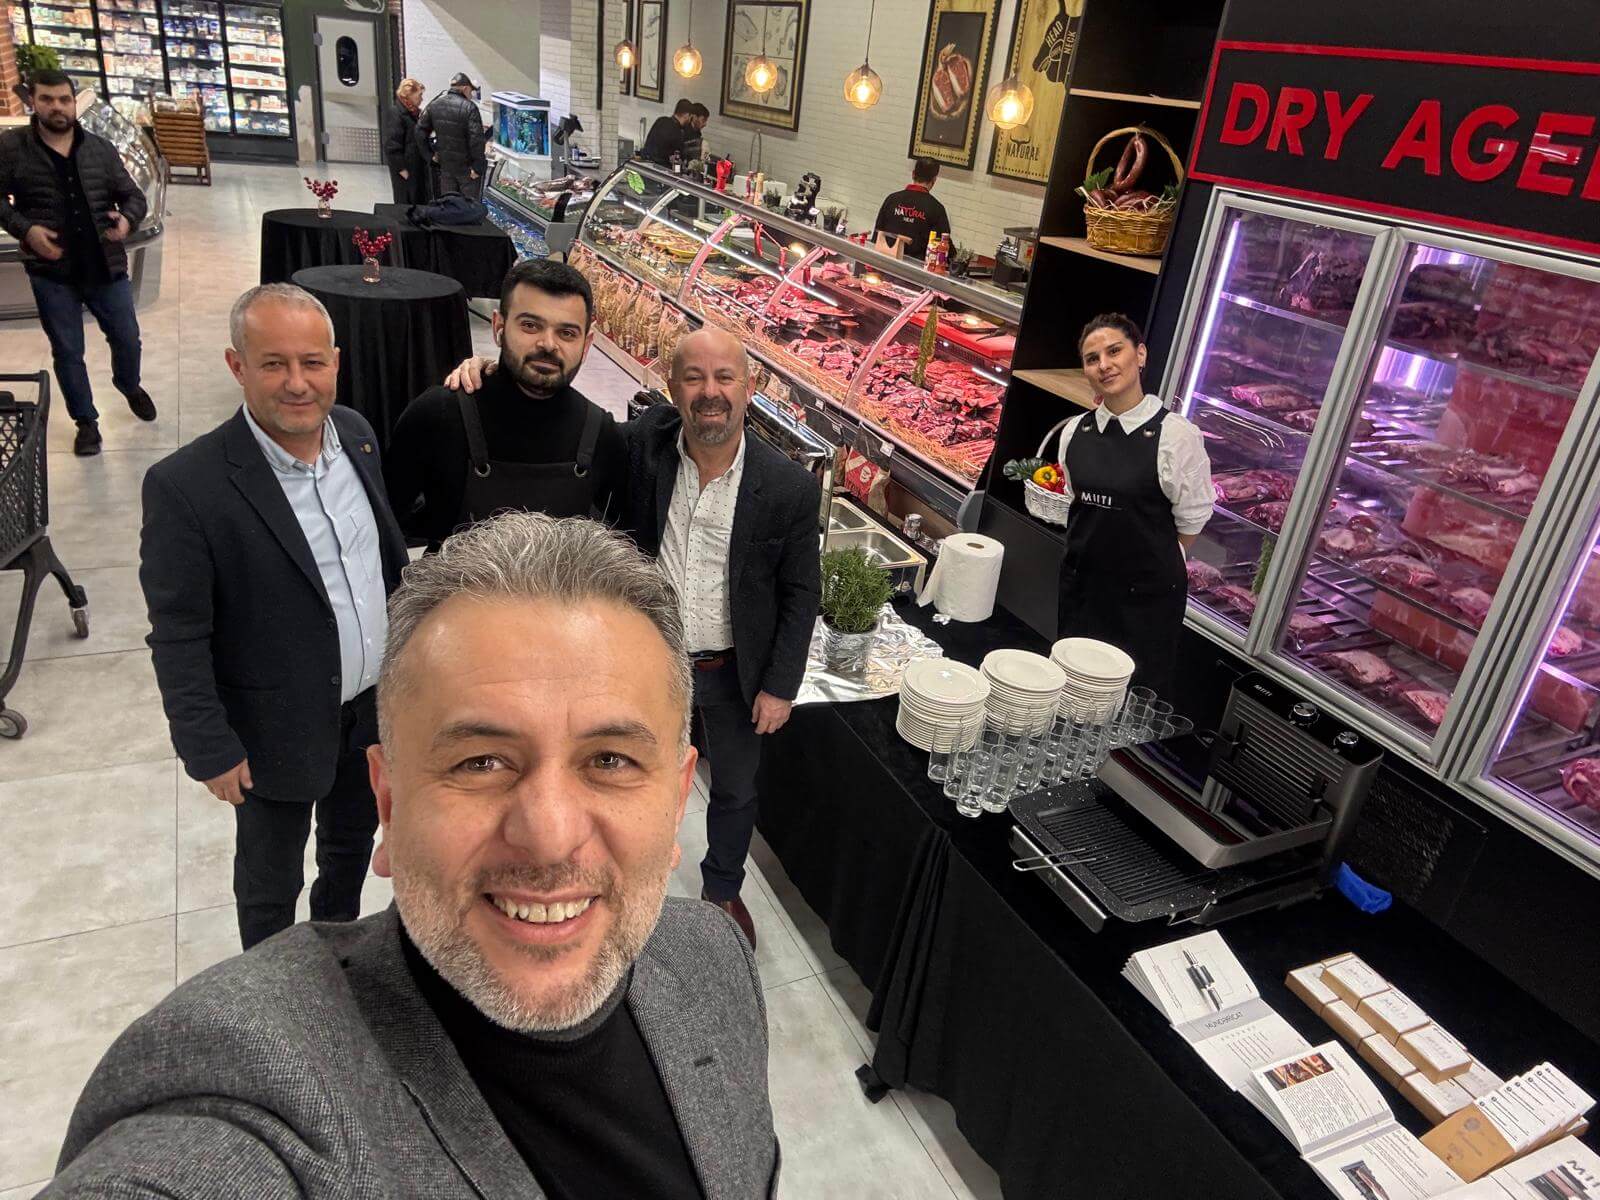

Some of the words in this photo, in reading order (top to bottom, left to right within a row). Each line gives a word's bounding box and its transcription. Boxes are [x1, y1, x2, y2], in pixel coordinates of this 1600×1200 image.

[1045, 20, 1064, 47] HEAD
[1063, 31, 1077, 55] NECK
[1219, 82, 1375, 161] DRY
[1005, 138, 1040, 162] NATURAL
[894, 205, 927, 221] NATURAL
